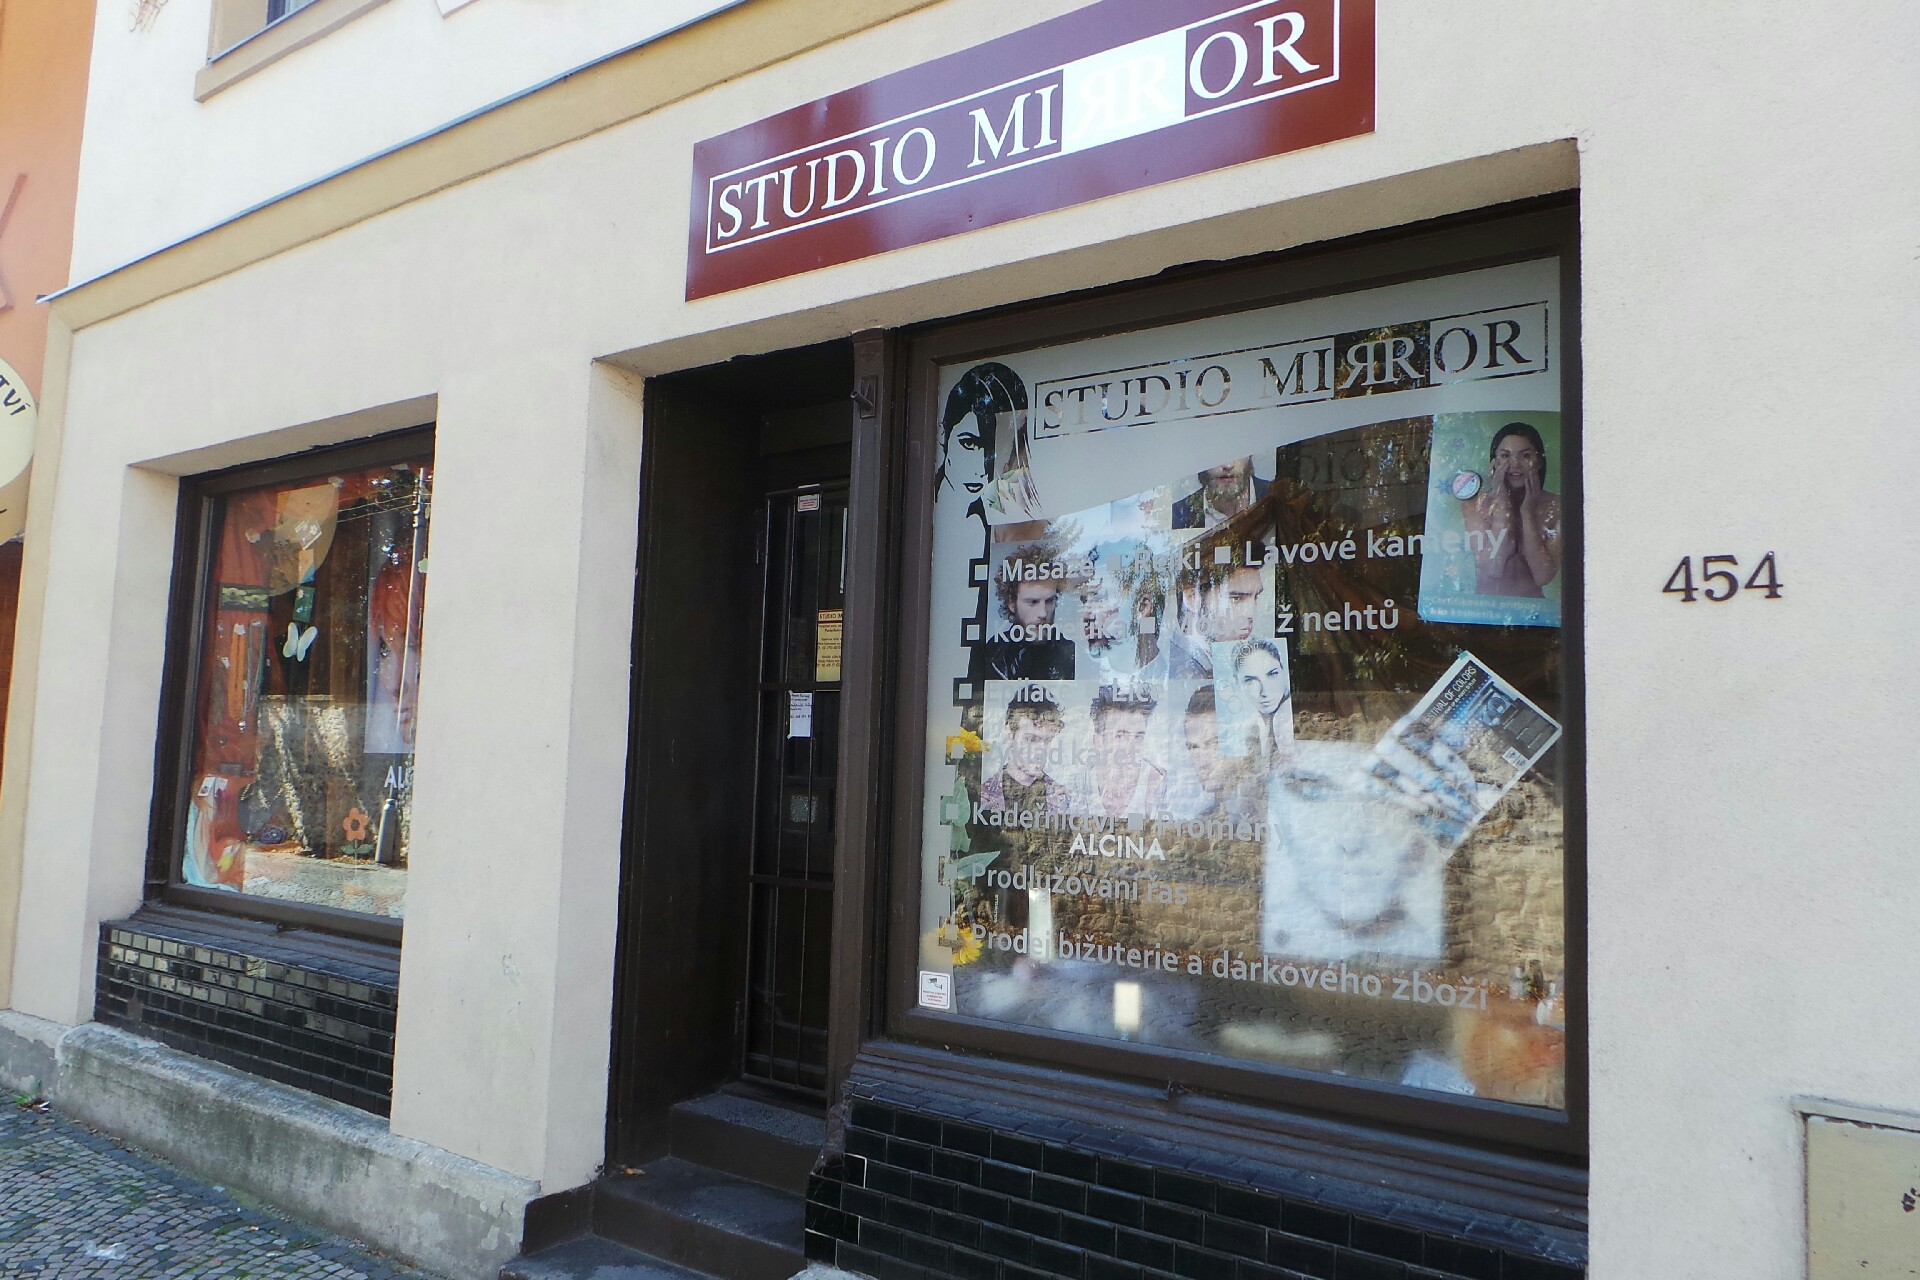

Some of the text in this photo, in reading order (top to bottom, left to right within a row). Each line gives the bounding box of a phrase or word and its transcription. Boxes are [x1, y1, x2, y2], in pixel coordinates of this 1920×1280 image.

[716, 126, 937, 240] STUDIO
[1042, 319, 1533, 431] STUDIO MIRROR
[1135, 542, 1201, 572] Reiki
[1245, 529, 1357, 567] Lávové
[1366, 527, 1508, 560] kameny
[1662, 550, 1784, 602] 454
[1303, 598, 1400, 632] nehtů
[1444, 690, 1455, 701] OF
[1452, 665, 1478, 693] COLORS
[1068, 833, 1167, 861] ALCINA
[1156, 810, 1283, 852] Proměny
[972, 864, 1188, 905] Prodlužování řas
[972, 924, 1490, 1011] Prodej bižuterie a dárkového zboží
